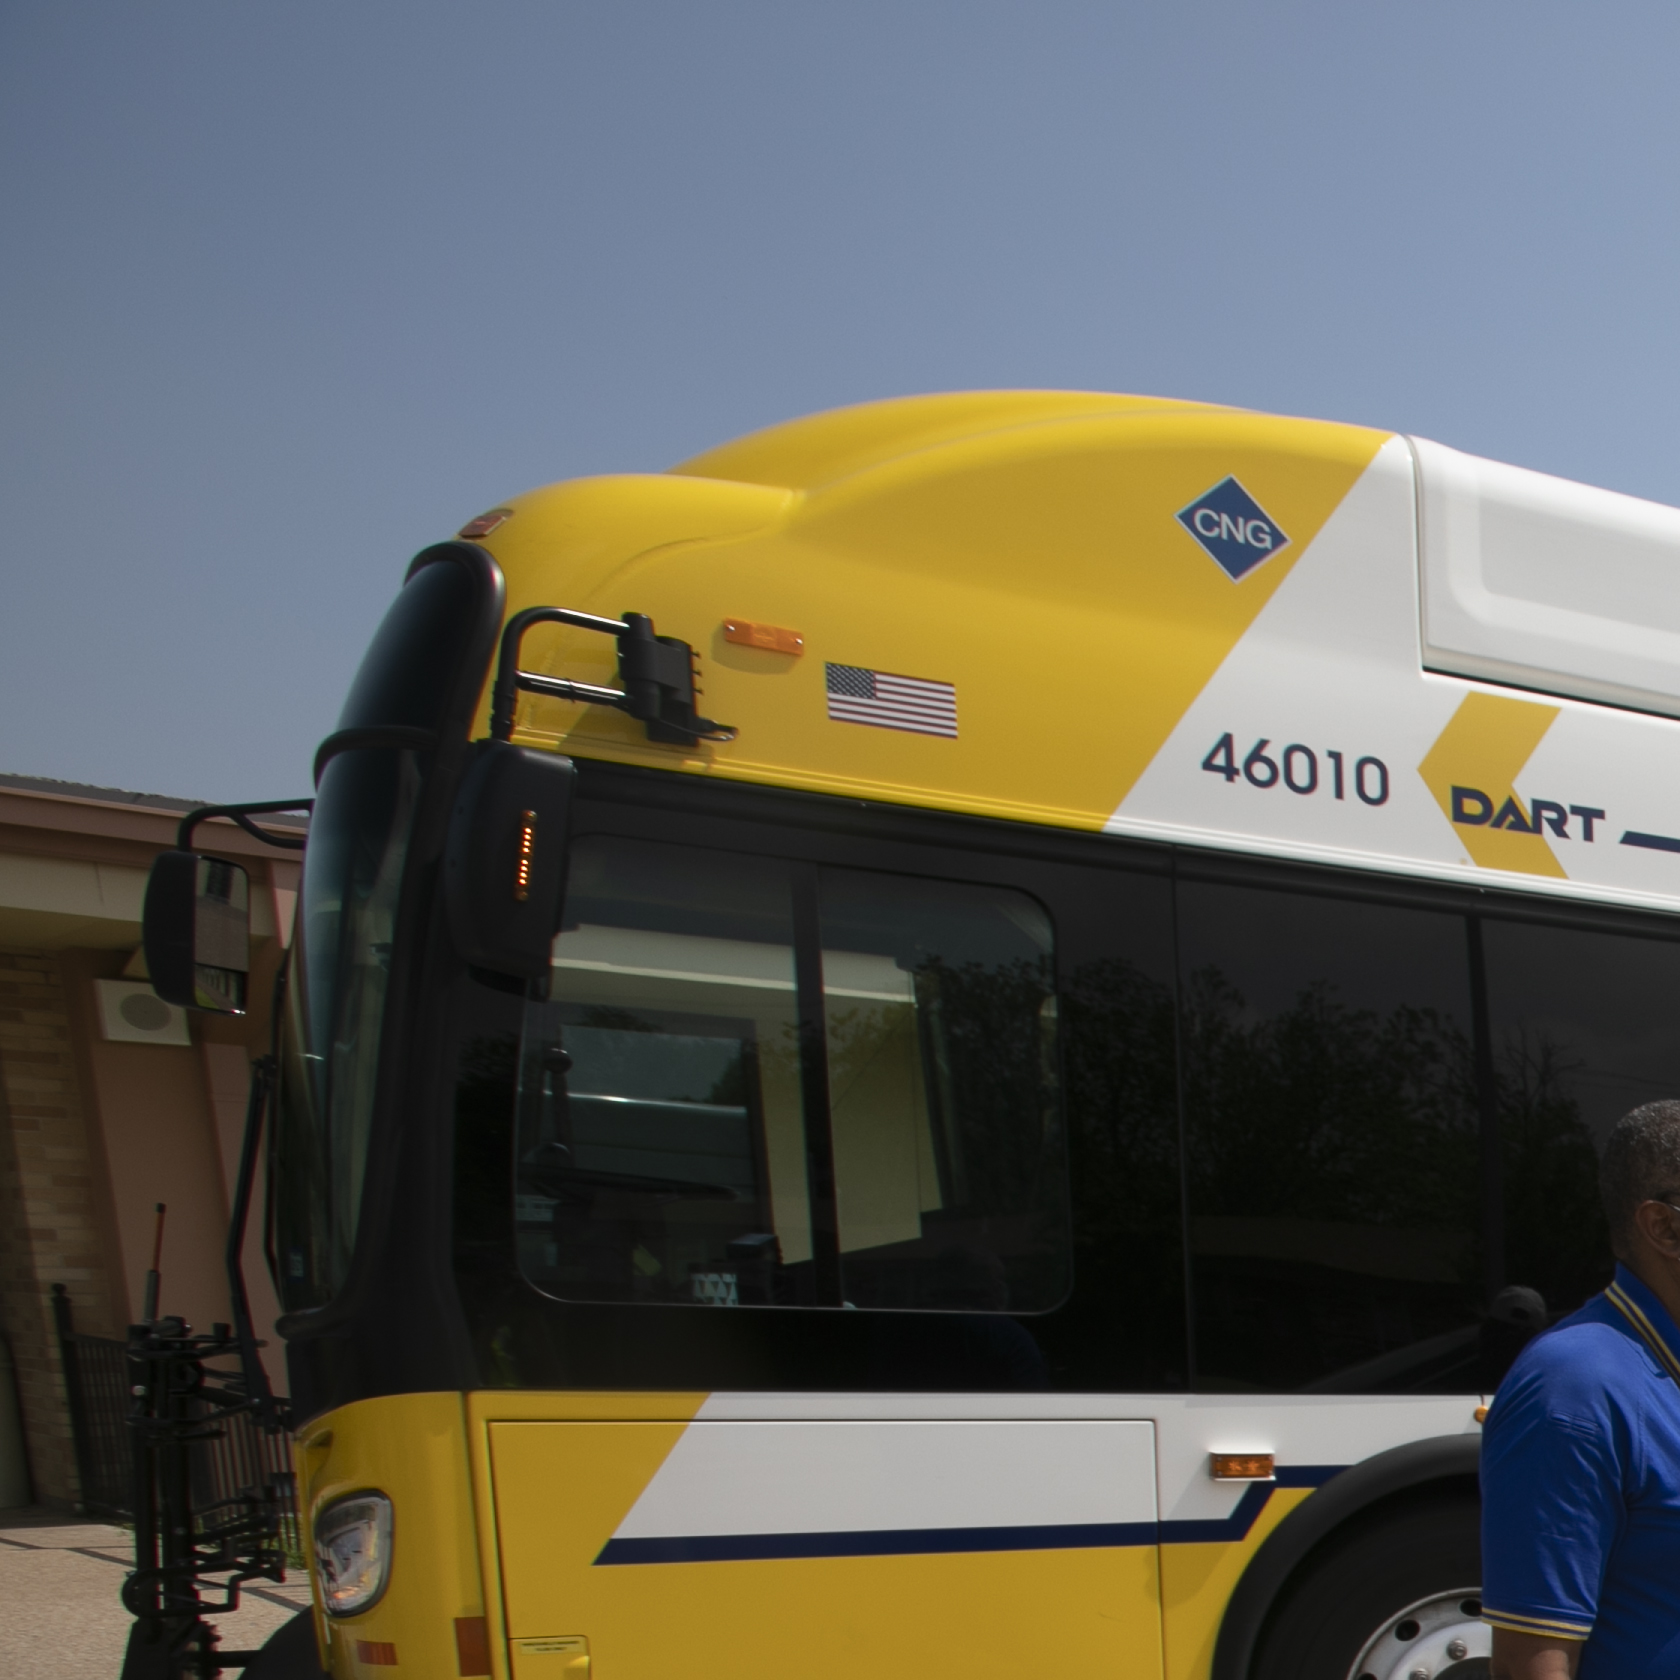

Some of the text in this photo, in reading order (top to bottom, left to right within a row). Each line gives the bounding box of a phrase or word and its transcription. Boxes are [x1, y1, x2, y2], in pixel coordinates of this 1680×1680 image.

[1193, 508, 1272, 550] CNG
[1202, 732, 1390, 806] 46010
[1451, 785, 1606, 842] DART
